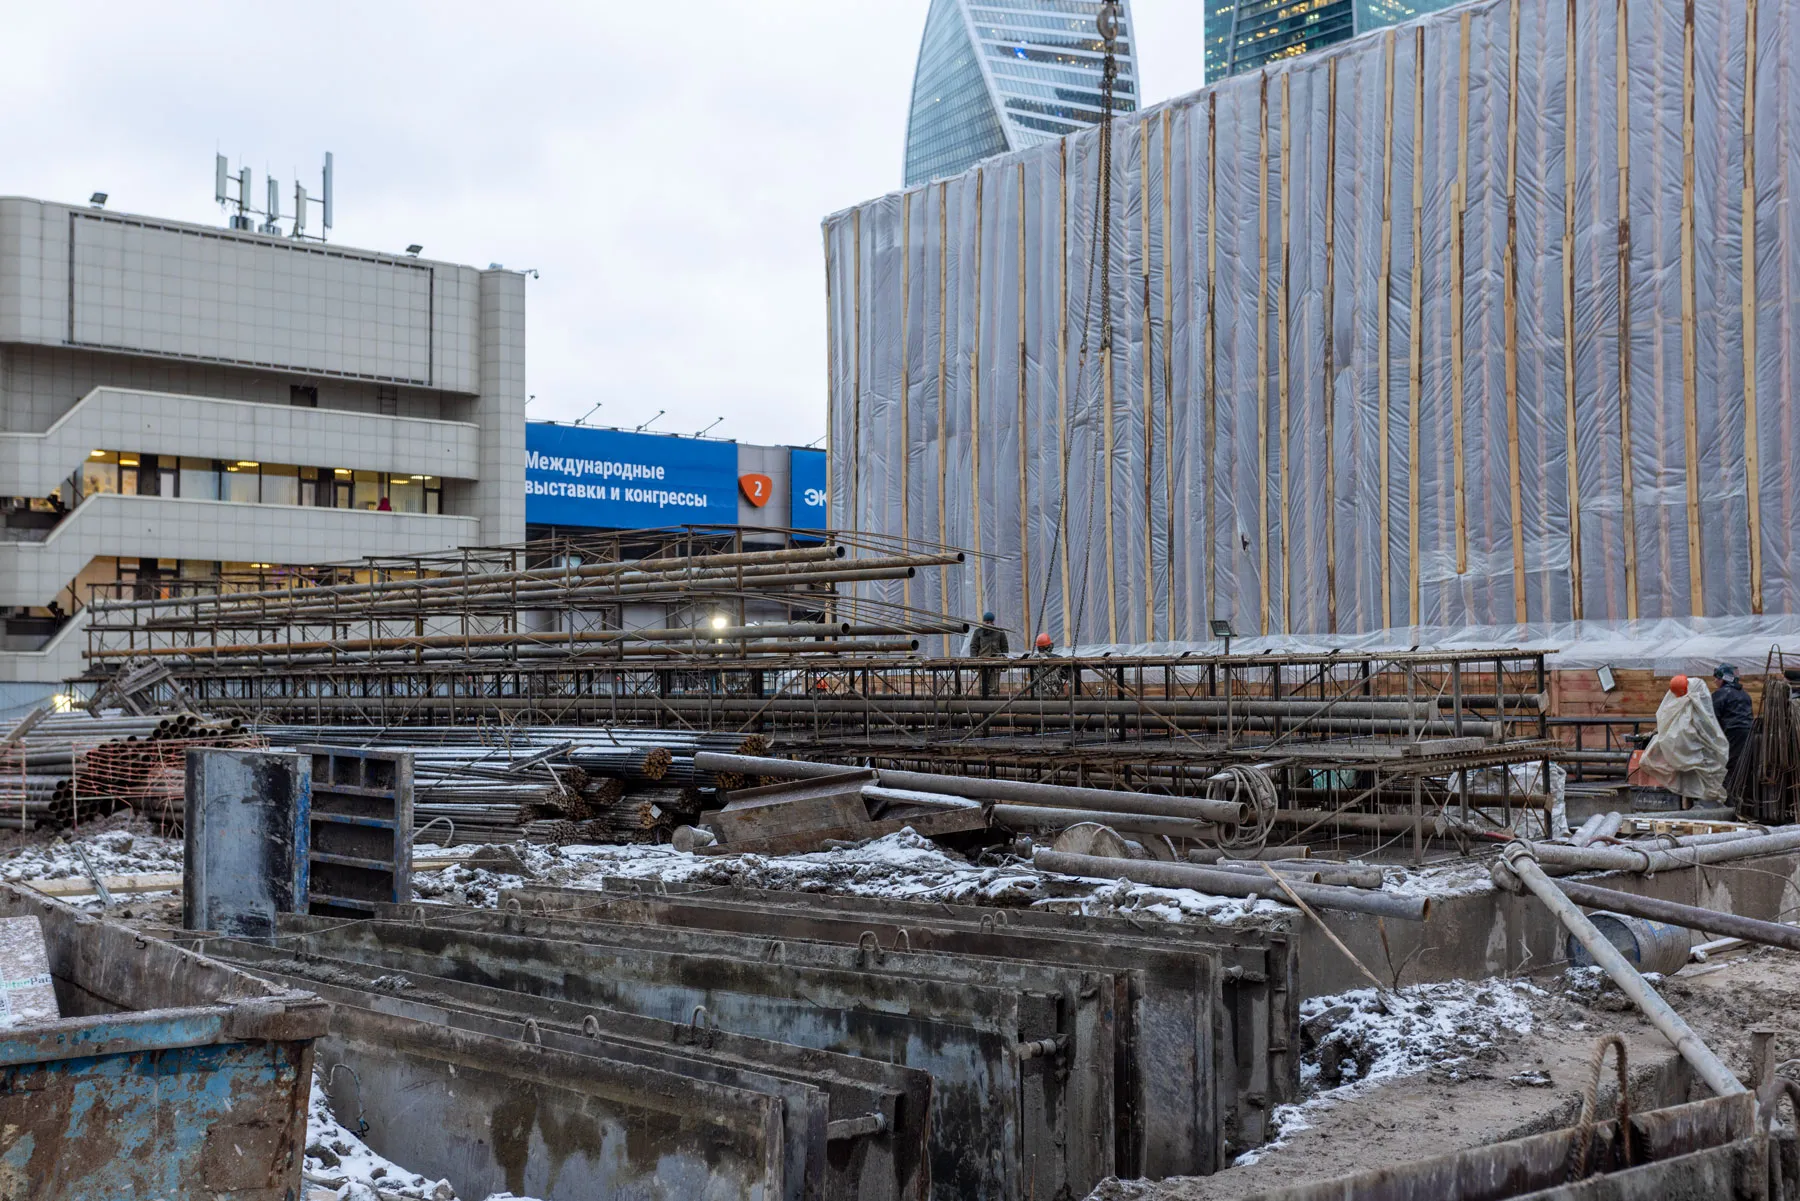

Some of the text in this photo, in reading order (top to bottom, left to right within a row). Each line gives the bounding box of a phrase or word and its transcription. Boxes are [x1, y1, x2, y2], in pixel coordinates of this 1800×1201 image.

[525, 450, 665, 481] Международные
[525, 480, 707, 508] выставки и конгрессы
[754, 480, 763, 497] 2
